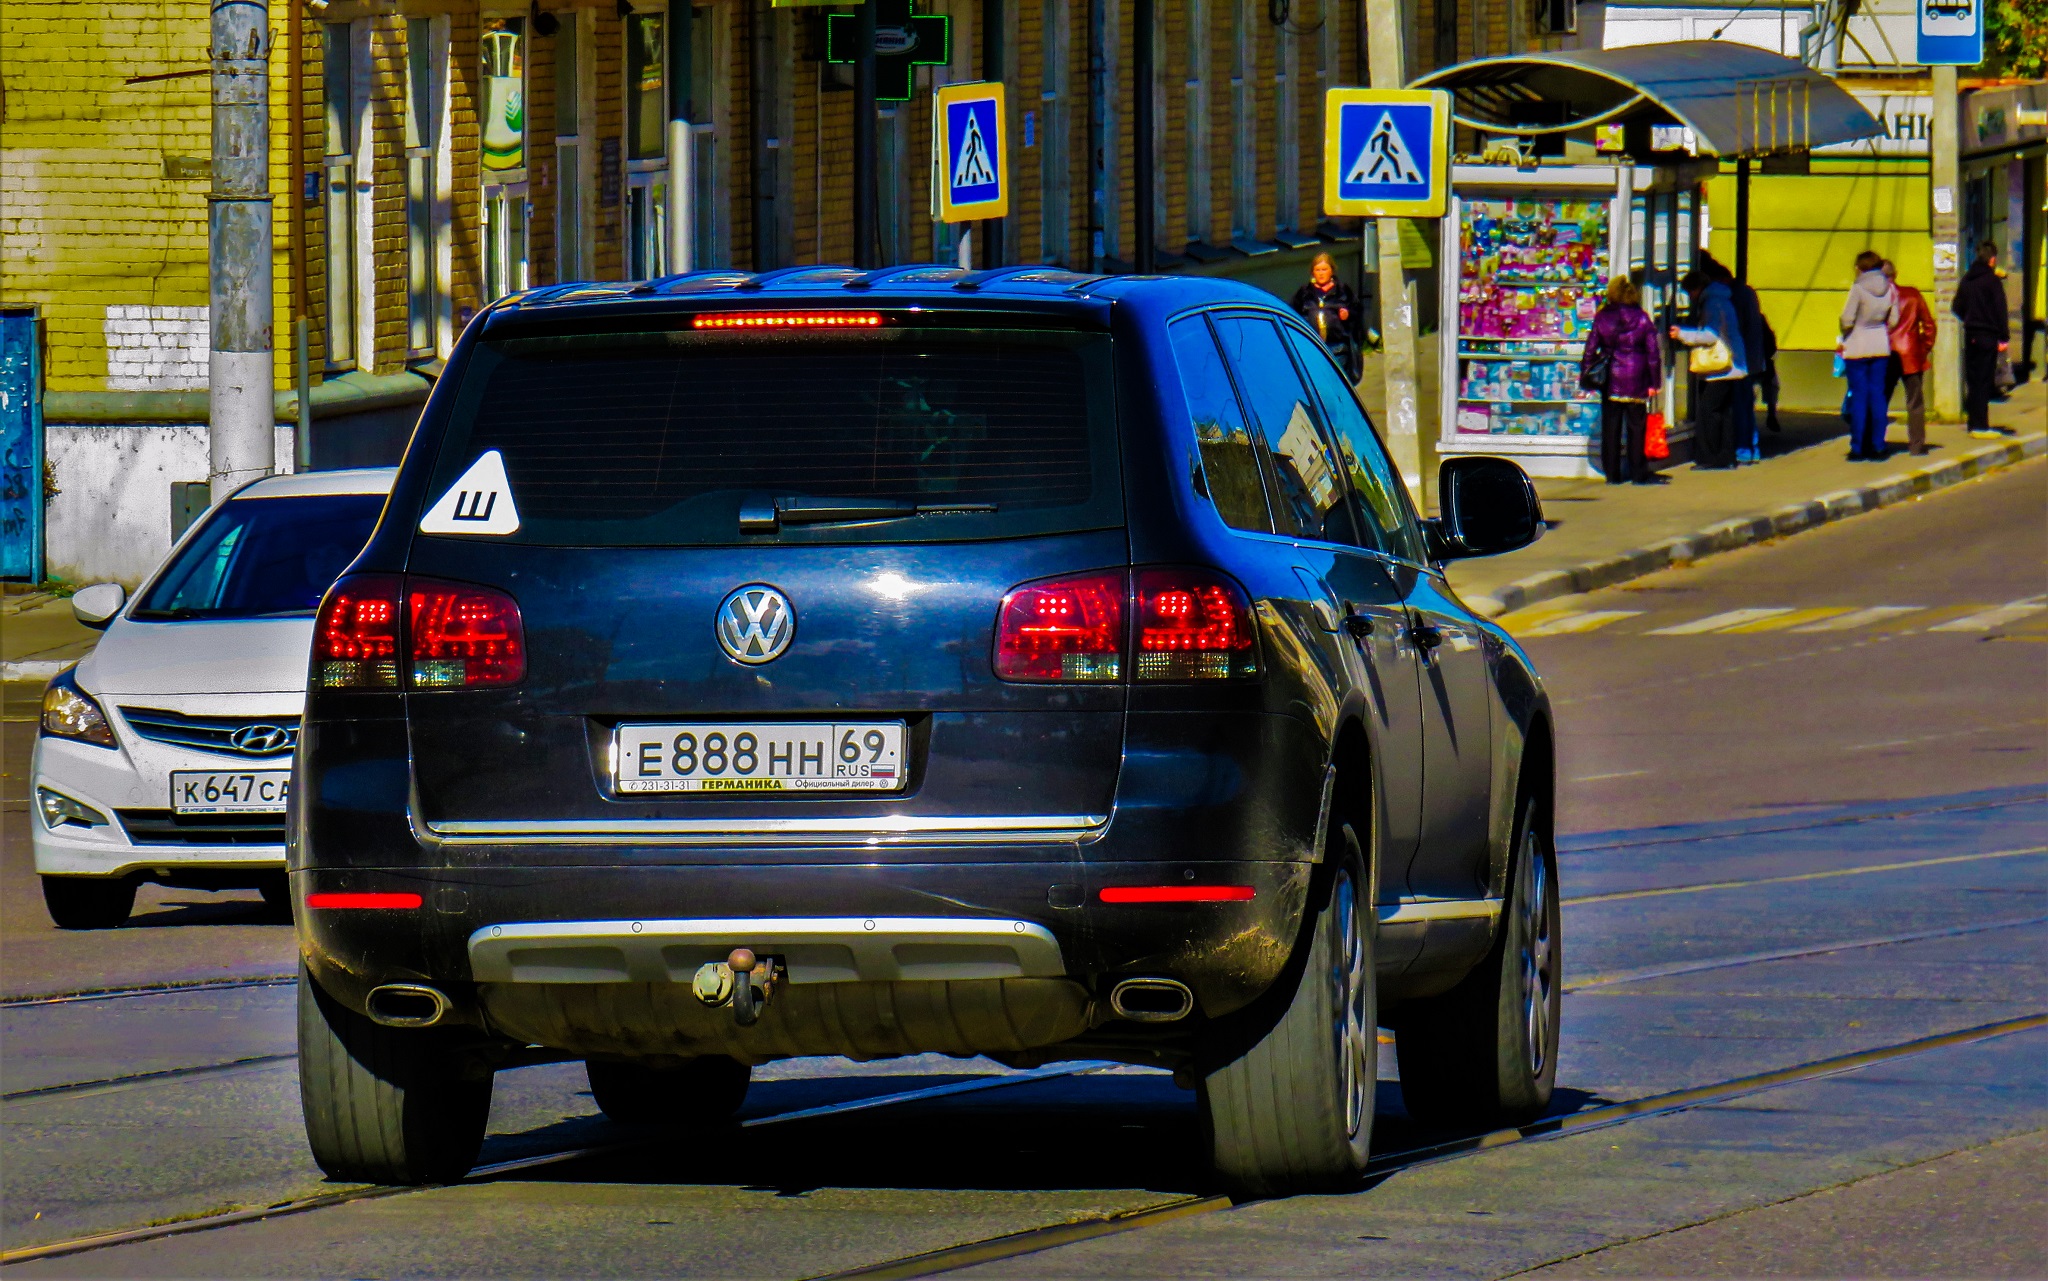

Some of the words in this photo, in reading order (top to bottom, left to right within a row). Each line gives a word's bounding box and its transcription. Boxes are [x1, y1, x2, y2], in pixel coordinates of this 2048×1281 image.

[452, 491, 497, 521] Ш
[638, 731, 824, 777] Е888НН
[839, 729, 886, 763] 69
[836, 764, 870, 776] RUS
[641, 781, 690, 791] 231-31-31
[701, 779, 782, 789] ГЕРМАНИКА
[794, 778, 850, 789] Официальный
[851, 780, 875, 788] дилер
